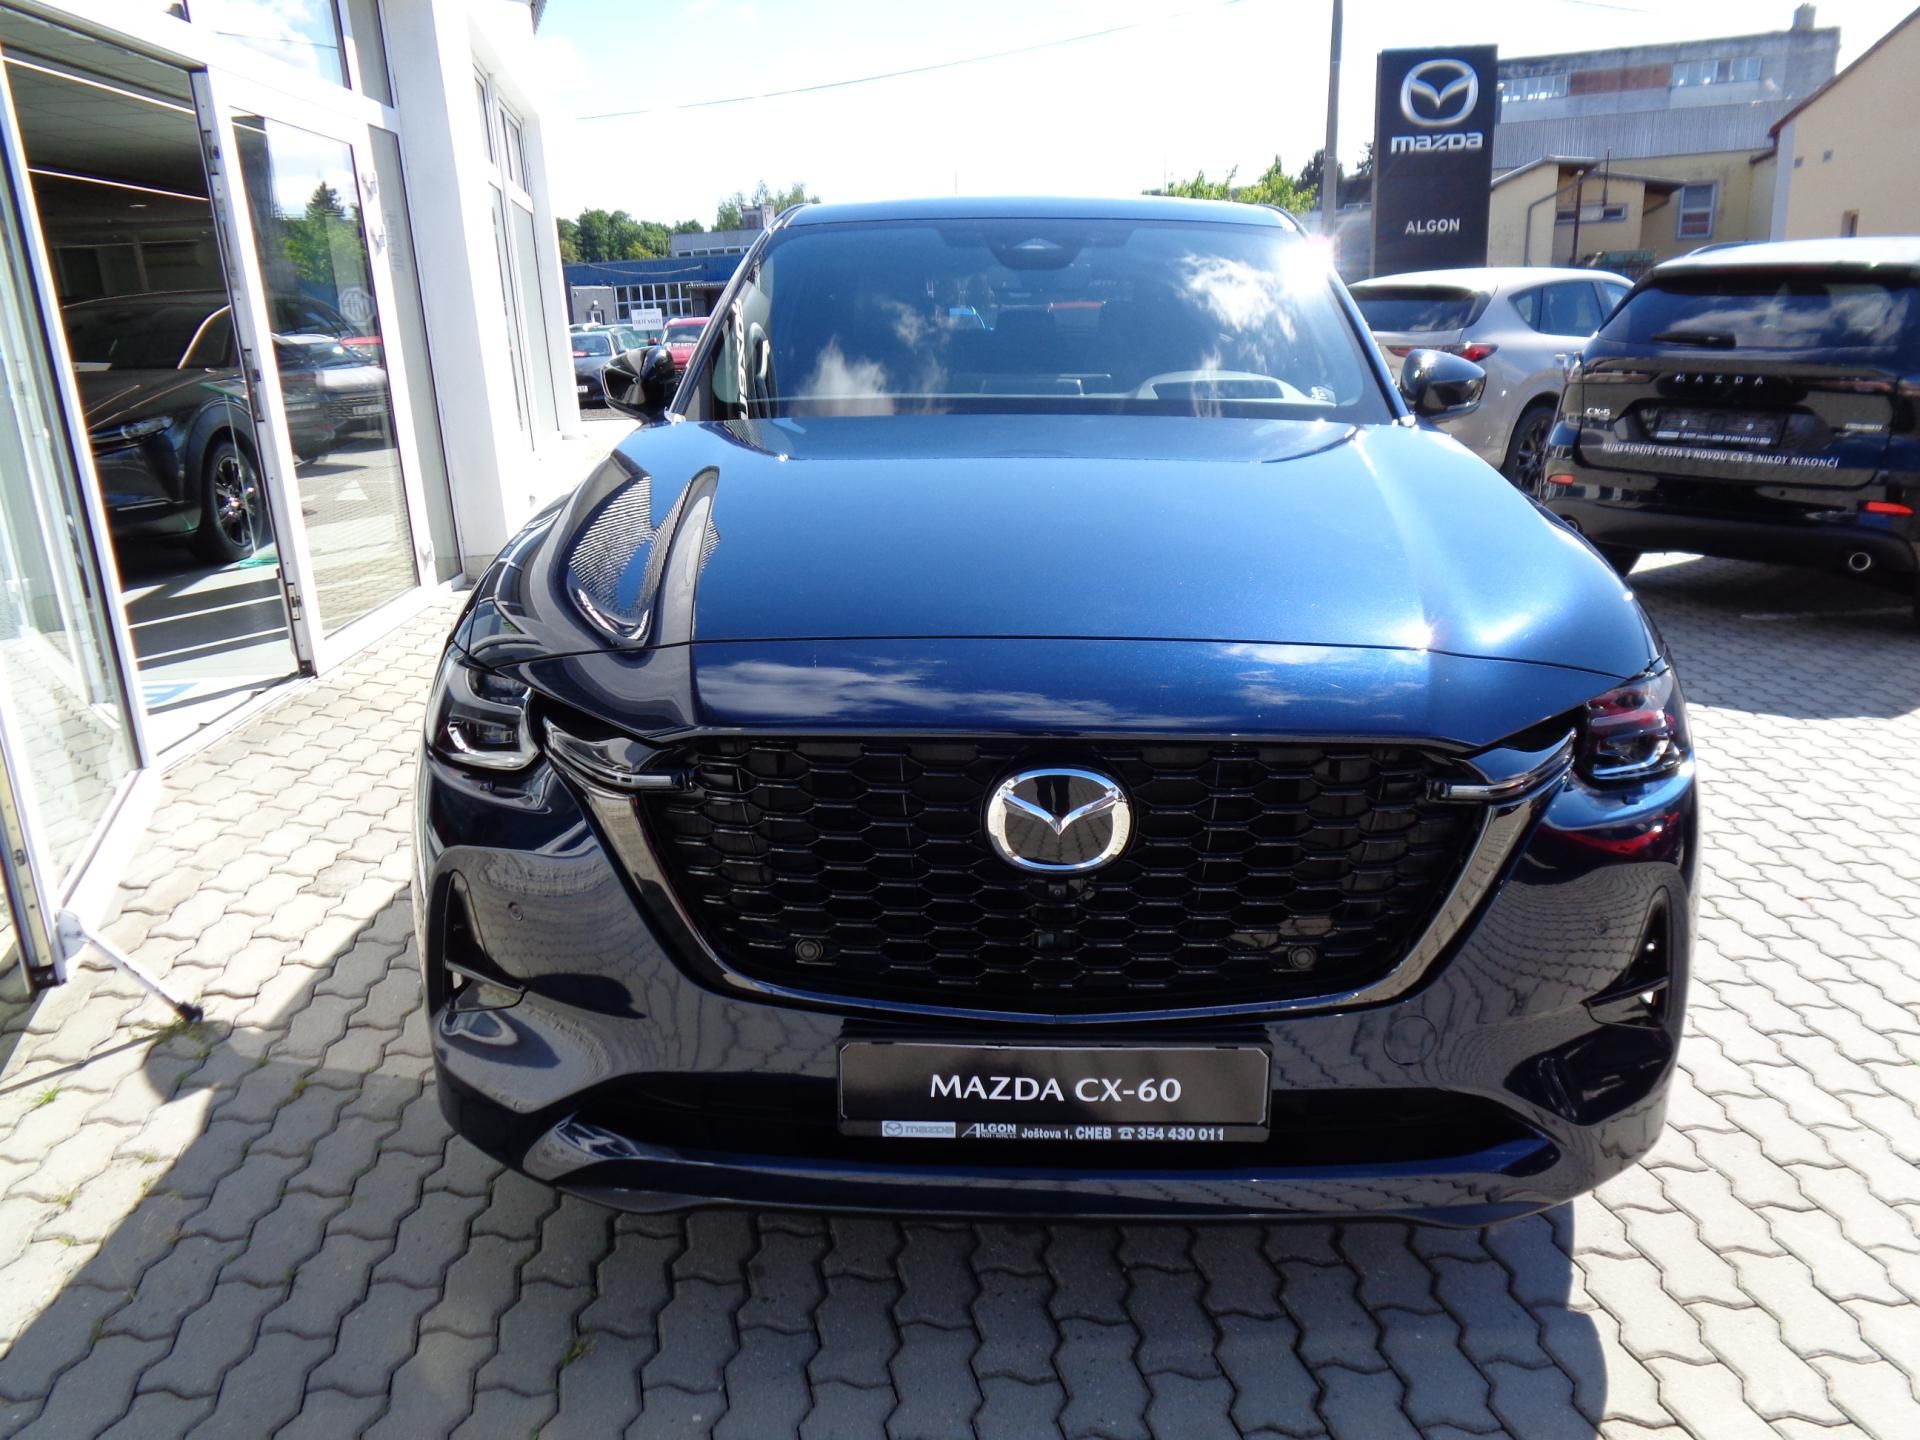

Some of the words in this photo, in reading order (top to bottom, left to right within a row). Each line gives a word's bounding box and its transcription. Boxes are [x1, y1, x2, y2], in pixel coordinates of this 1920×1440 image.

[1405, 218, 1461, 235] ALGON
[1674, 373, 1764, 385] MAZDA
[1587, 407, 1611, 416] CX-5
[1657, 447, 1683, 457] CESTA
[1694, 450, 1728, 461] NOVOU
[1730, 453, 1754, 462] CX-5
[1757, 454, 1788, 465] NIKDY
[1791, 456, 1840, 469] NEKONČÍ
[930, 1074, 1065, 1102] MAZDA
[1075, 1078, 1182, 1103] CX-60
[961, 1122, 1017, 1138] ALGON
[1021, 1127, 1061, 1139] Joštova
[1075, 1126, 1112, 1140] CHEB
[1137, 1127, 1164, 1140] 354
[1167, 1127, 1195, 1140] 430
[1198, 1128, 1224, 1141] 011
